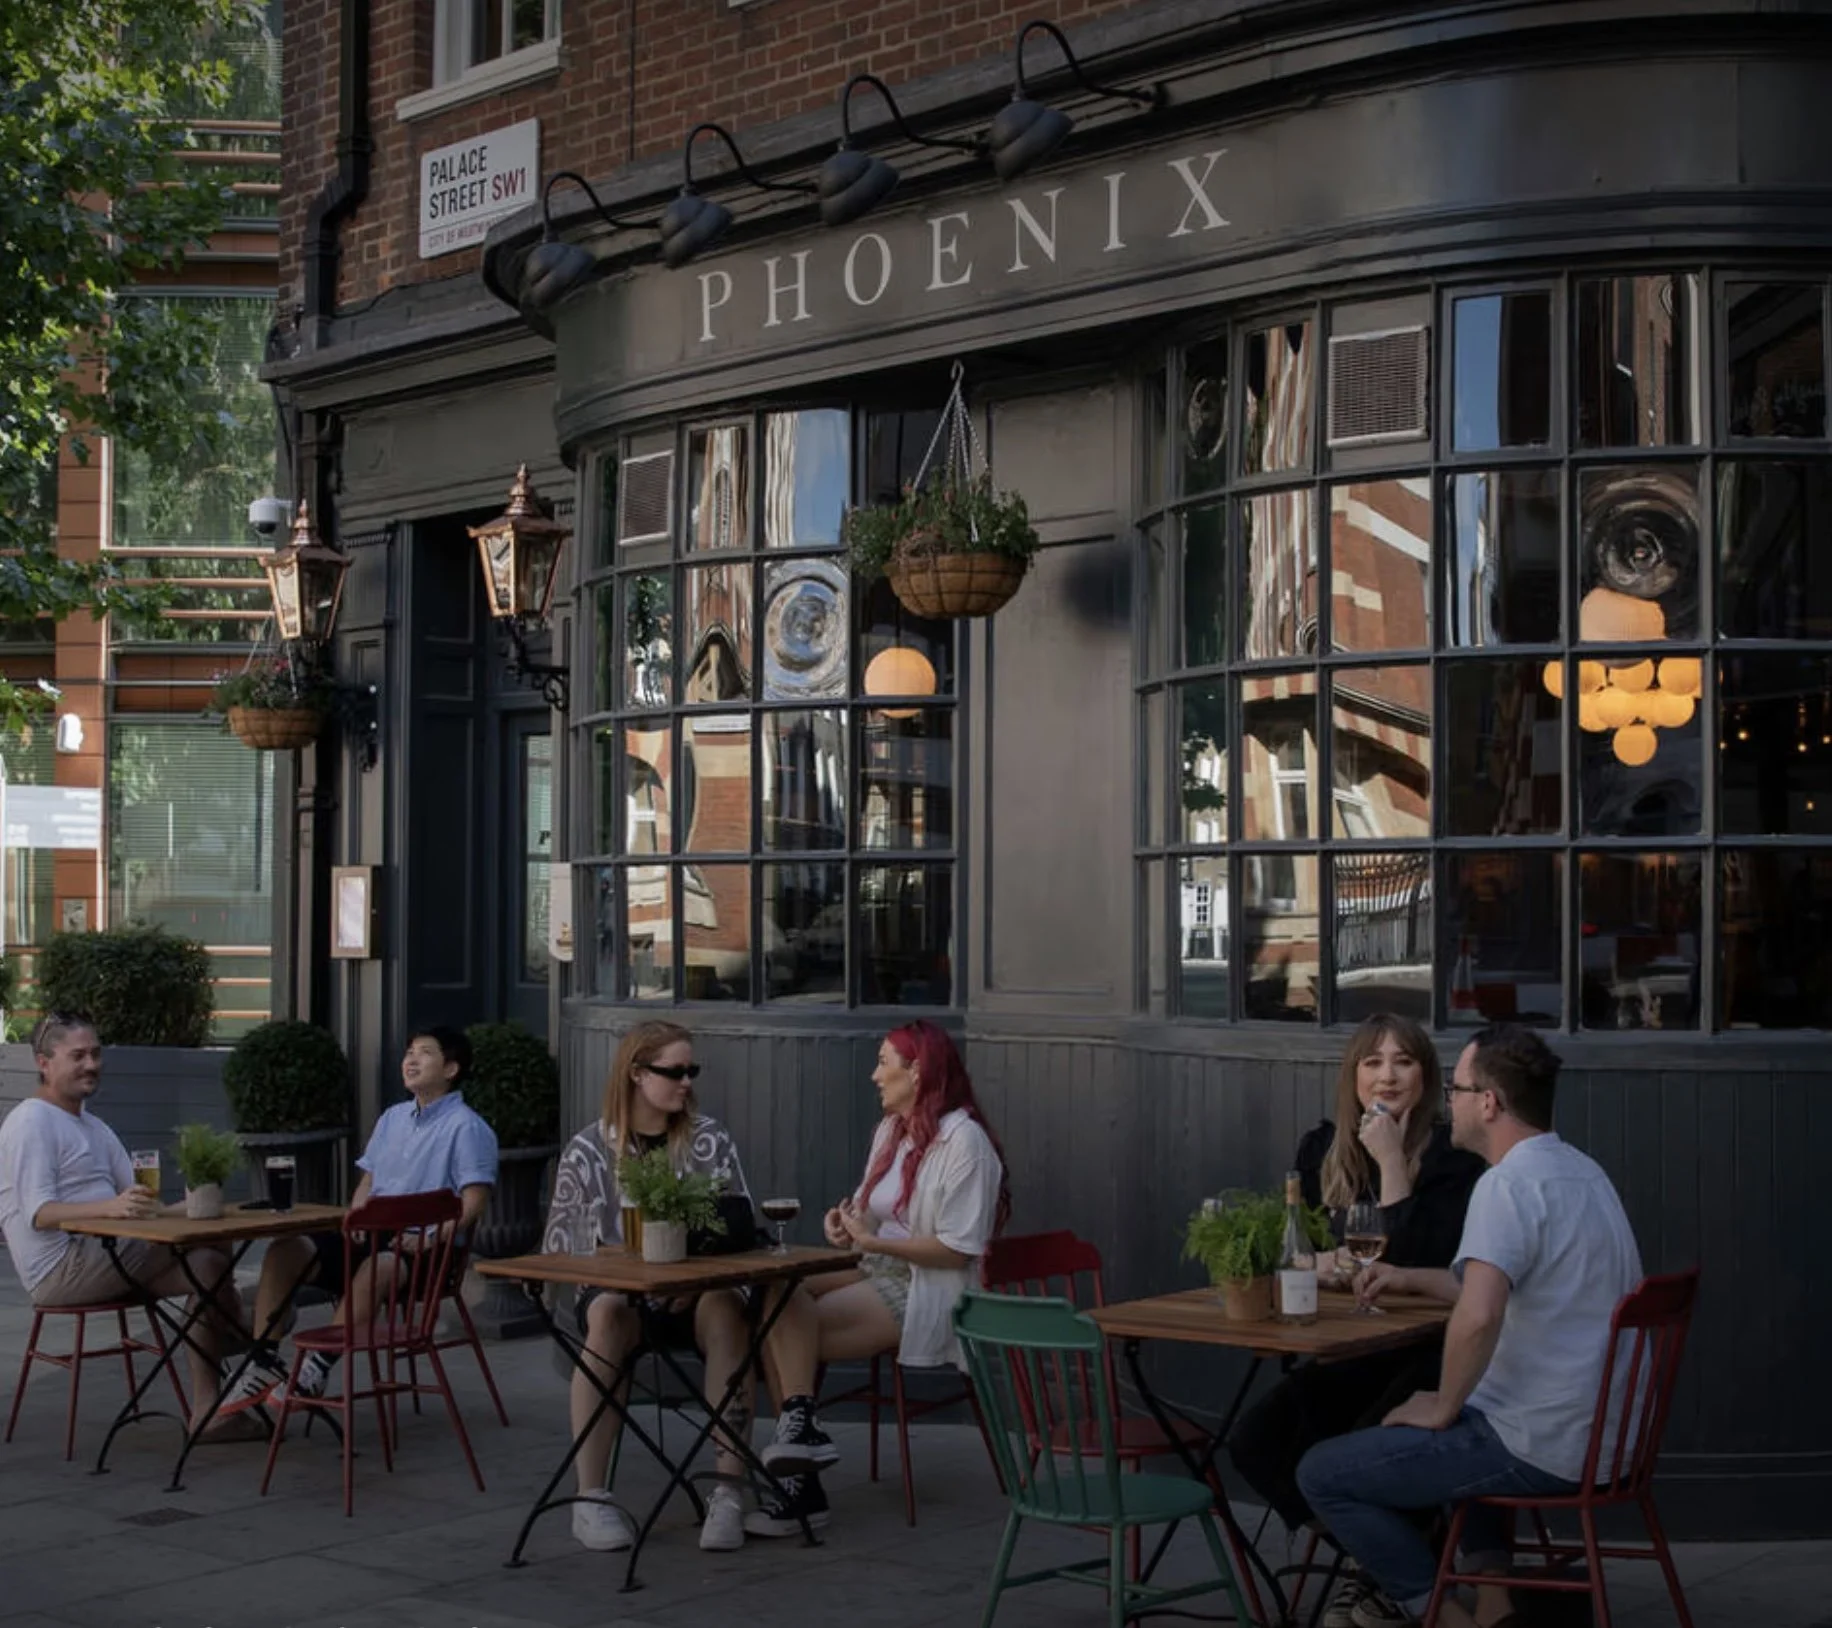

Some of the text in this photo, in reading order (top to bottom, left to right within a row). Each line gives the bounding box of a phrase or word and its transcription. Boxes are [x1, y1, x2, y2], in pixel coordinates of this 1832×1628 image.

[429, 145, 488, 187] PALACE
[429, 167, 526, 219] STREET SW1
[697, 148, 1231, 342] PHOENIX
